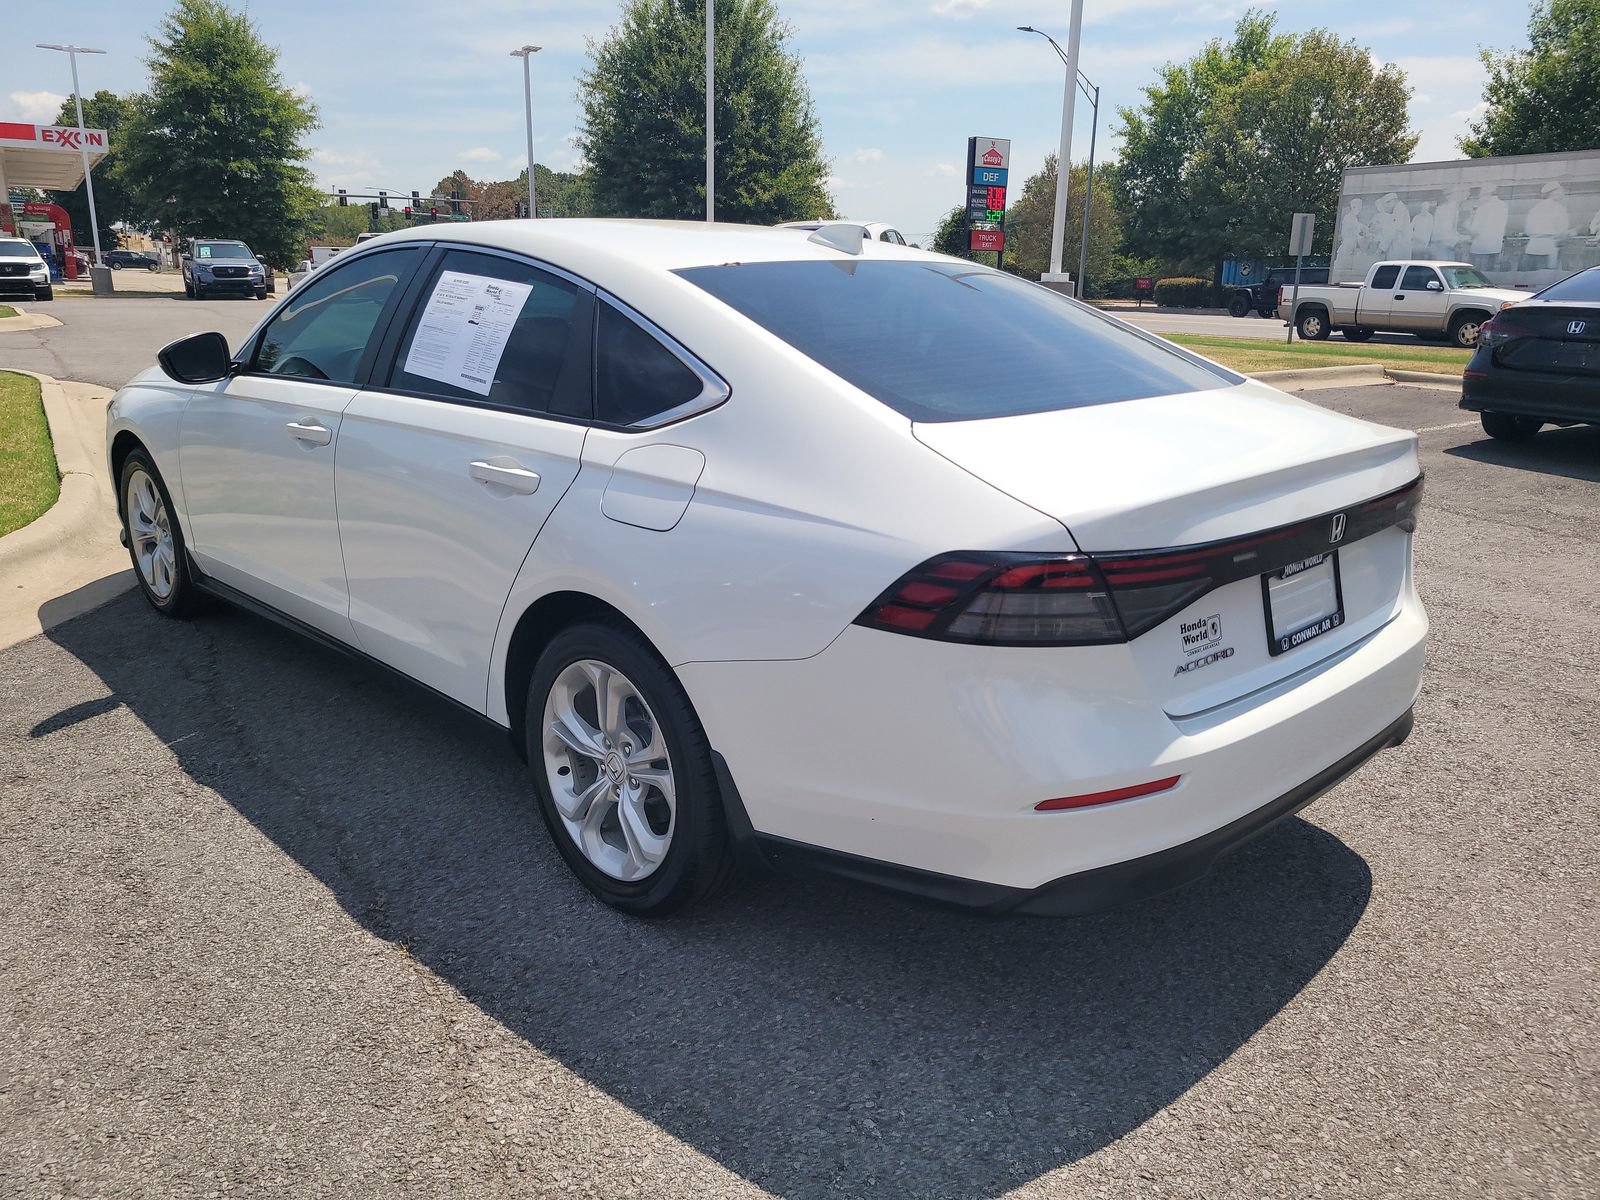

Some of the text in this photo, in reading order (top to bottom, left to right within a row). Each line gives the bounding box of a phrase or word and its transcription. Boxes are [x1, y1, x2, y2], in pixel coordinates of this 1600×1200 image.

[41, 128, 103, 149] EXXON
[983, 172, 999, 182] DEF
[1180, 618, 1206, 634] Honda
[1291, 618, 1331, 645] CONWAY, AR
[1183, 629, 1208, 646] World
[1174, 647, 1235, 678] ACCORD
